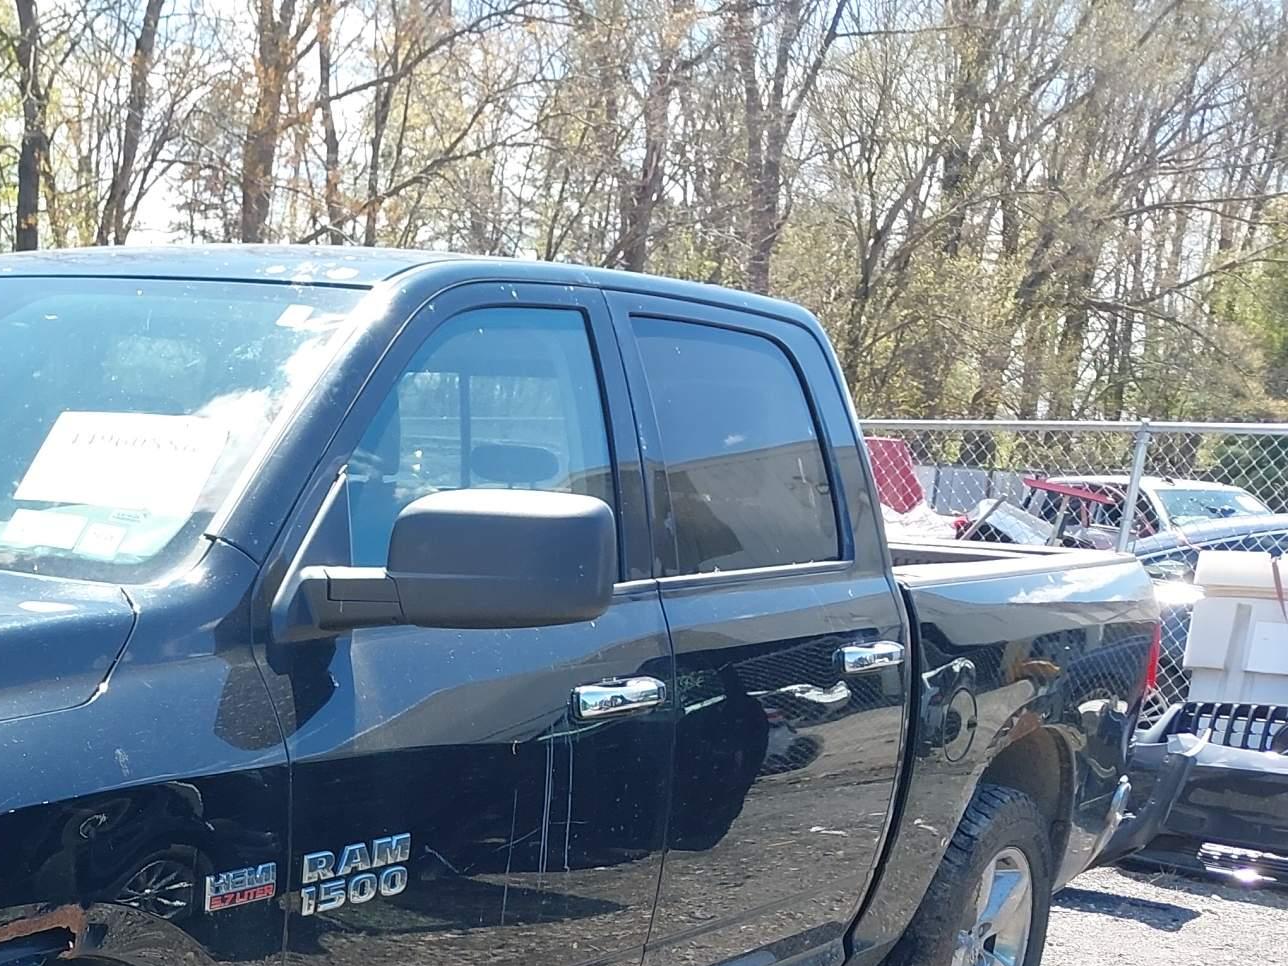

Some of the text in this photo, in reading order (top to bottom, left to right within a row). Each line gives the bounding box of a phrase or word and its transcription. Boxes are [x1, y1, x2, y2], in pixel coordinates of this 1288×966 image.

[206, 862, 277, 895] HEMI
[303, 833, 411, 884] RAM
[210, 884, 274, 909] 5.7 LITER
[301, 866, 409, 916] 1500
